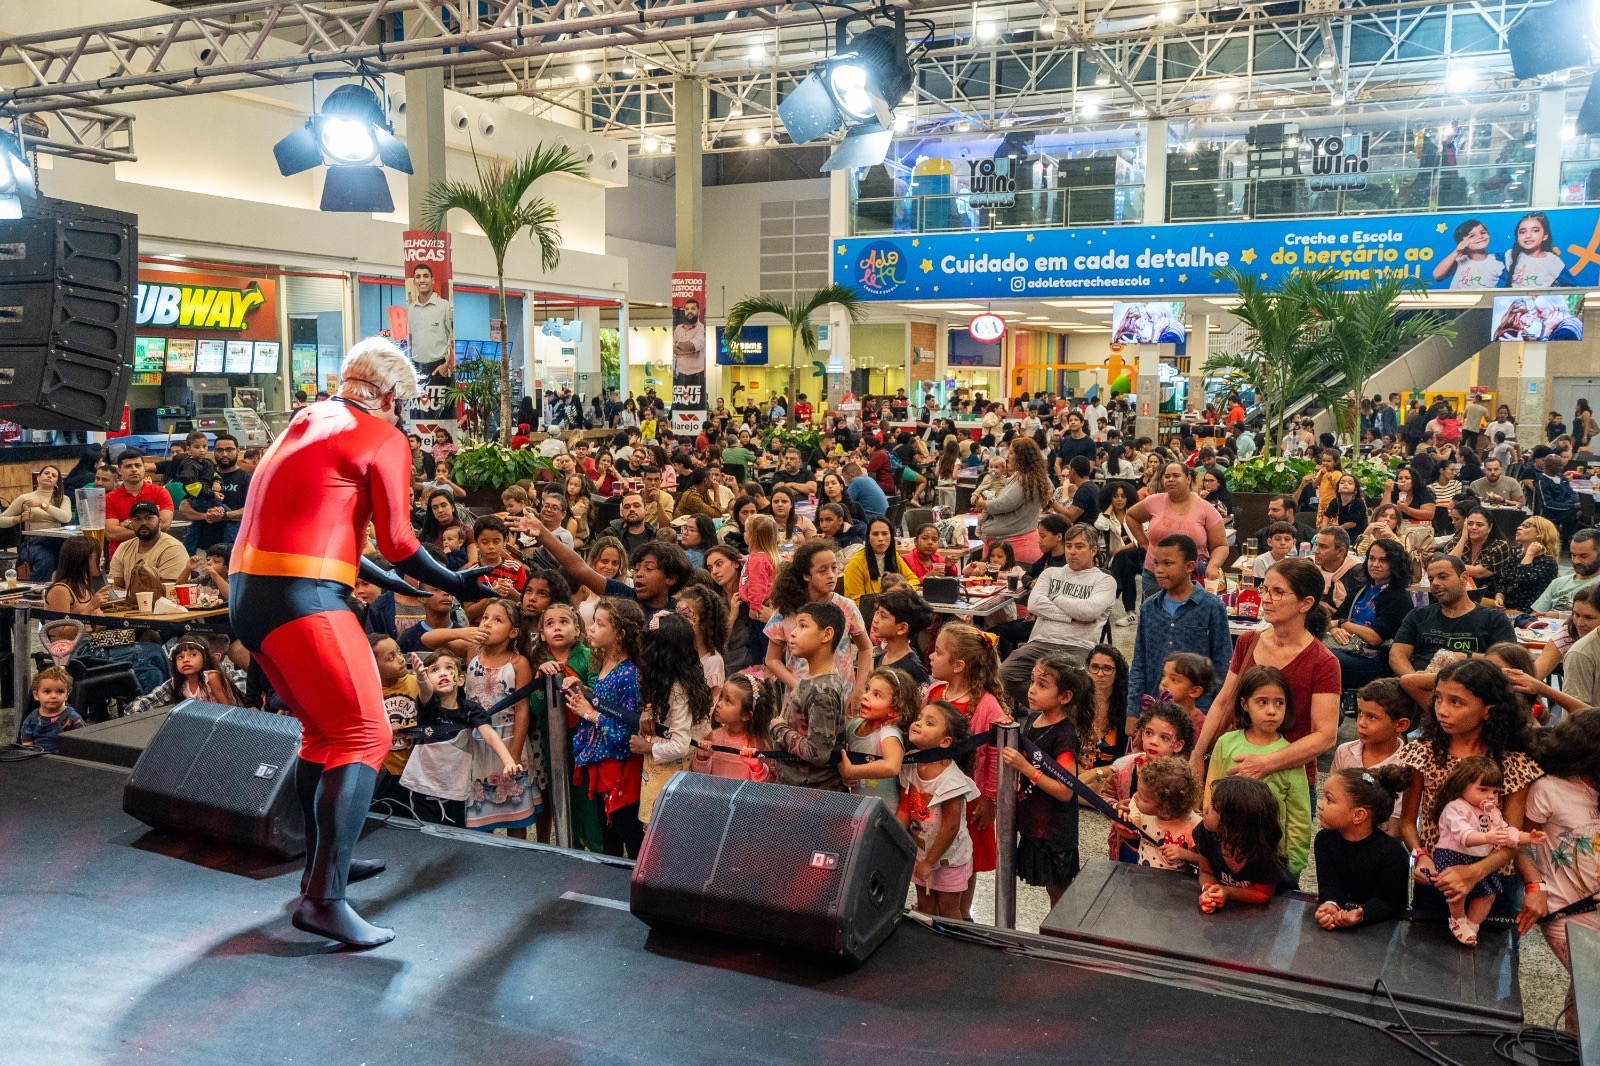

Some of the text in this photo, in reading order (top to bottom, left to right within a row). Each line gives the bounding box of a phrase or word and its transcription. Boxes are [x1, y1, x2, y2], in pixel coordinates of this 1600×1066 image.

[1310, 175, 1367, 191] GAMES
[1284, 229, 1403, 245] Creche e Escola
[940, 246, 1230, 274] Cuidado em cada detalhe
[1270, 243, 1434, 267] do berçário ao
[1027, 275, 1151, 289] adoletacrecheescola
[134, 284, 264, 328] UBWAY
[974, 320, 999, 334] C&A
[1453, 641, 1471, 650] ON
